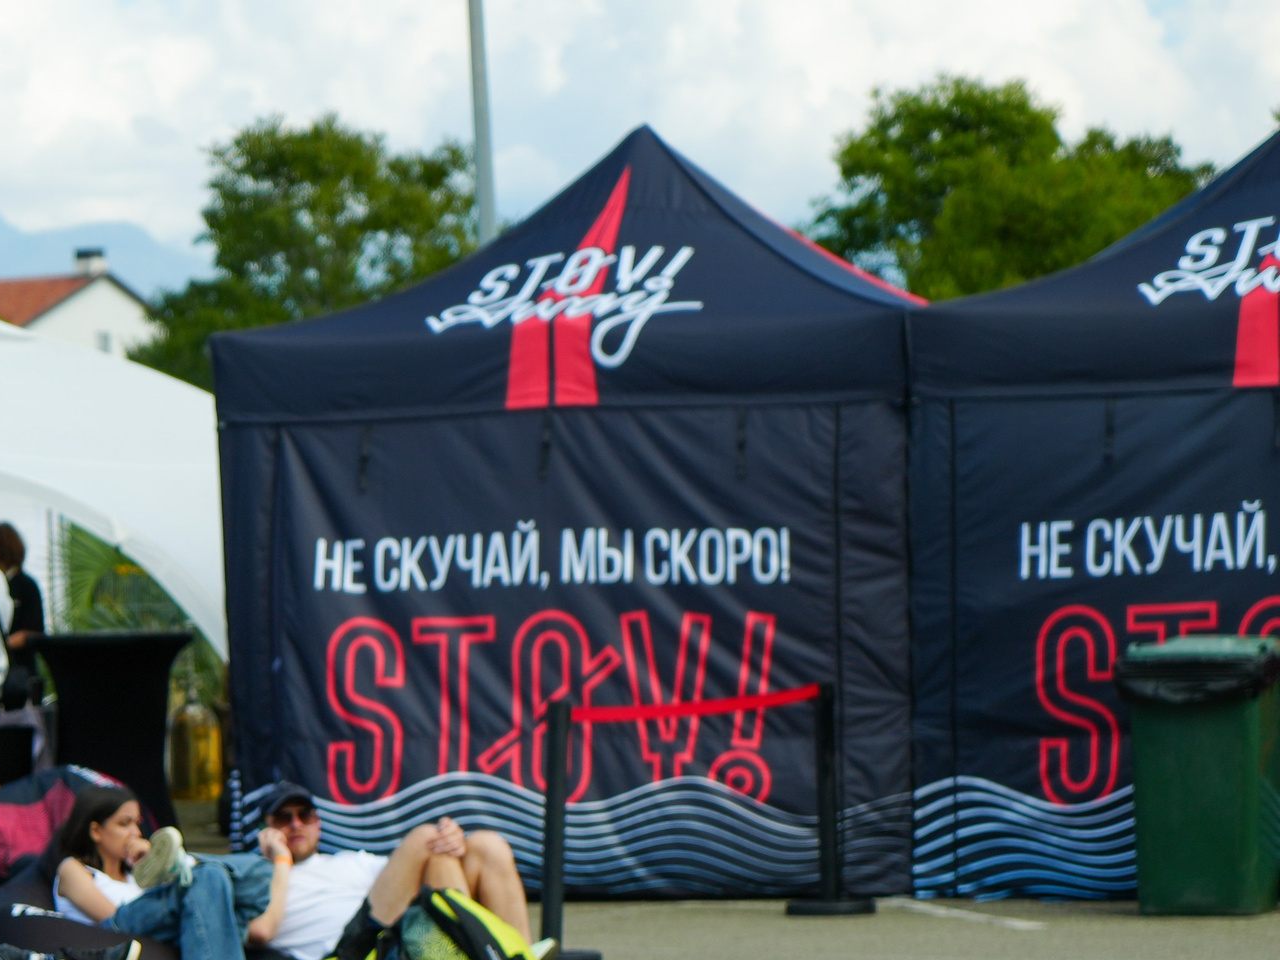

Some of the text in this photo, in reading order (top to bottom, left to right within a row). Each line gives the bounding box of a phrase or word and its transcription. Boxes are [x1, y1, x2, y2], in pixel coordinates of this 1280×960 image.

[1178, 215, 1280, 272] ST
[313, 519, 791, 594] НЕ СКУЧАЙ, МЫ СКОРО!
[1020, 498, 1278, 580] НЕ СКУЧАЙ,
